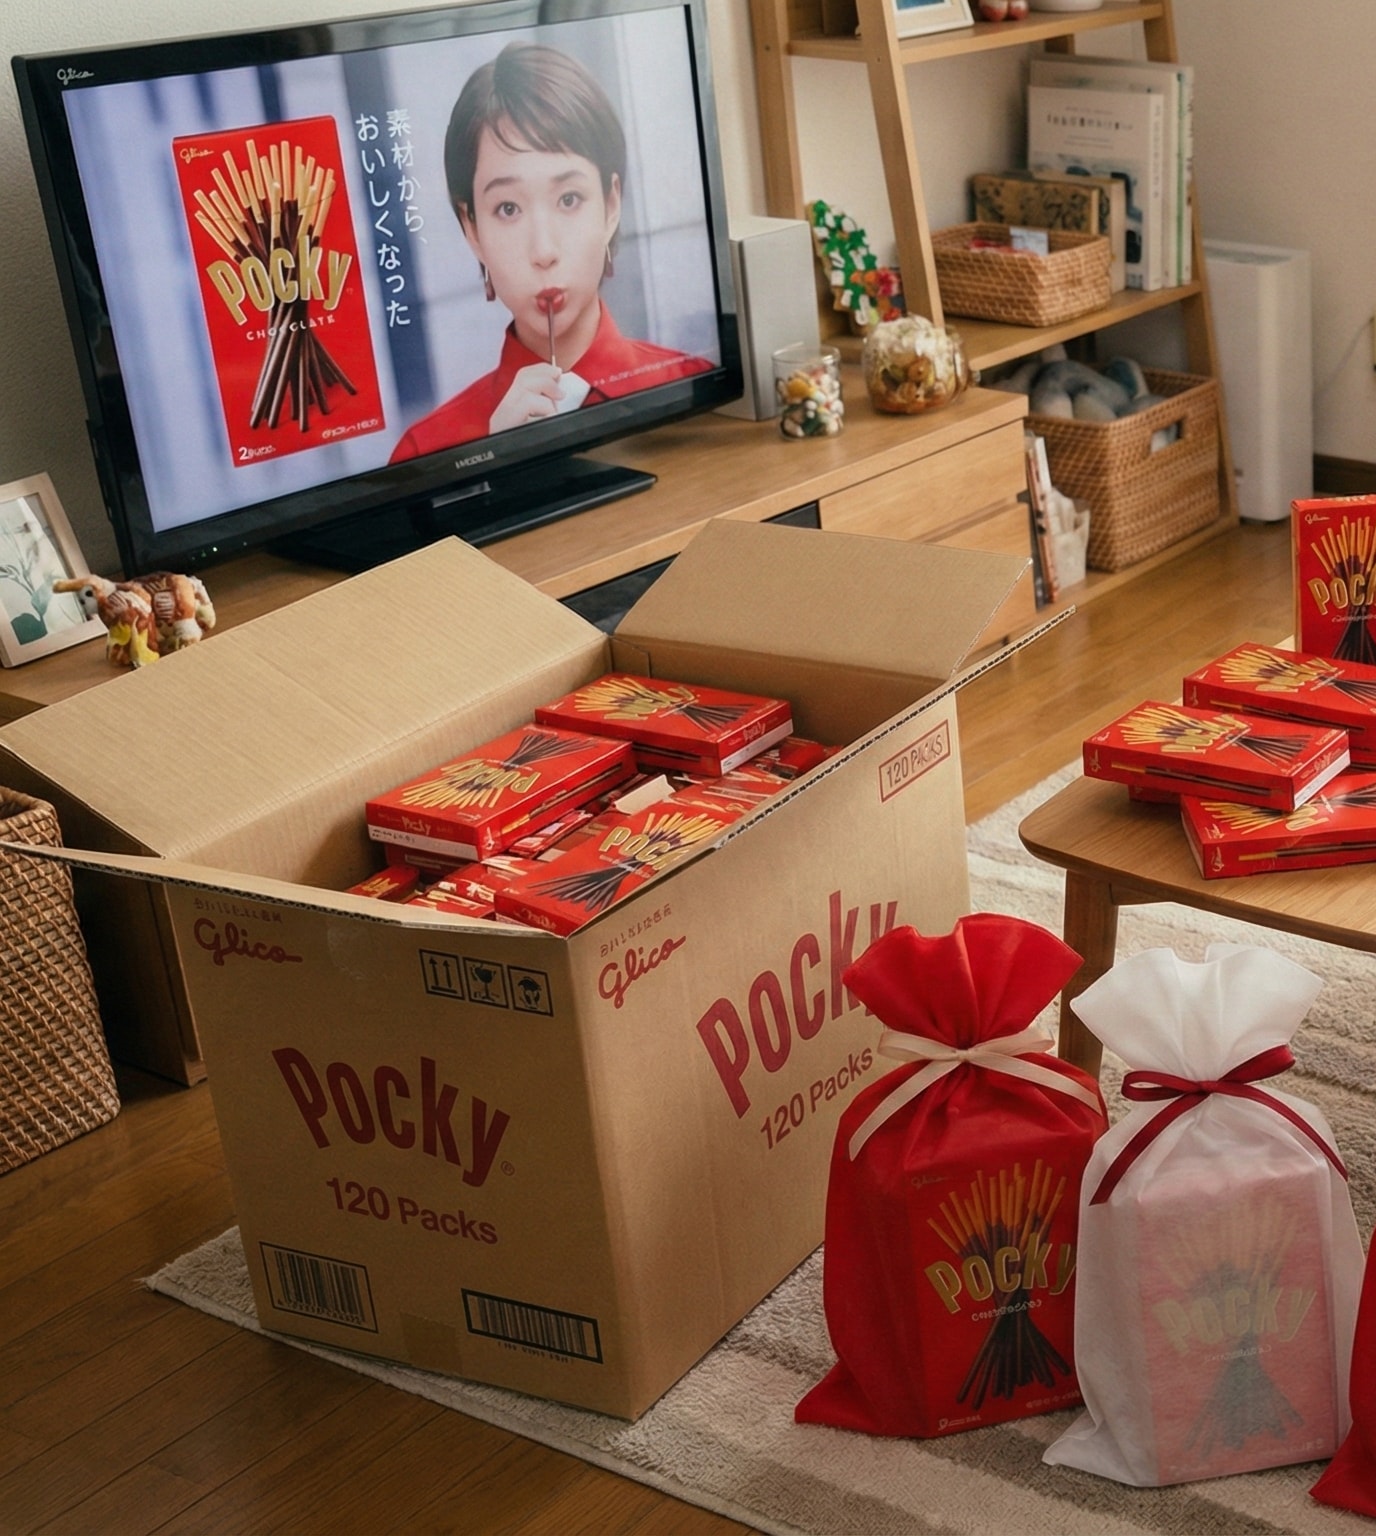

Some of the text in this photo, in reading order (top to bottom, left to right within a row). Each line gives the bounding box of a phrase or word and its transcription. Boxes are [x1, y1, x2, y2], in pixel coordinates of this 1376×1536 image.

[386, 108, 428, 245] 素材から、
[355, 113, 411, 328] おいしくなった
[886, 756, 909, 788] 120
[194, 917, 303, 967] Glico
[598, 935, 687, 1009] Glico
[760, 1047, 873, 1150] 120 Packs
[326, 1177, 498, 1245] 120 Packs
